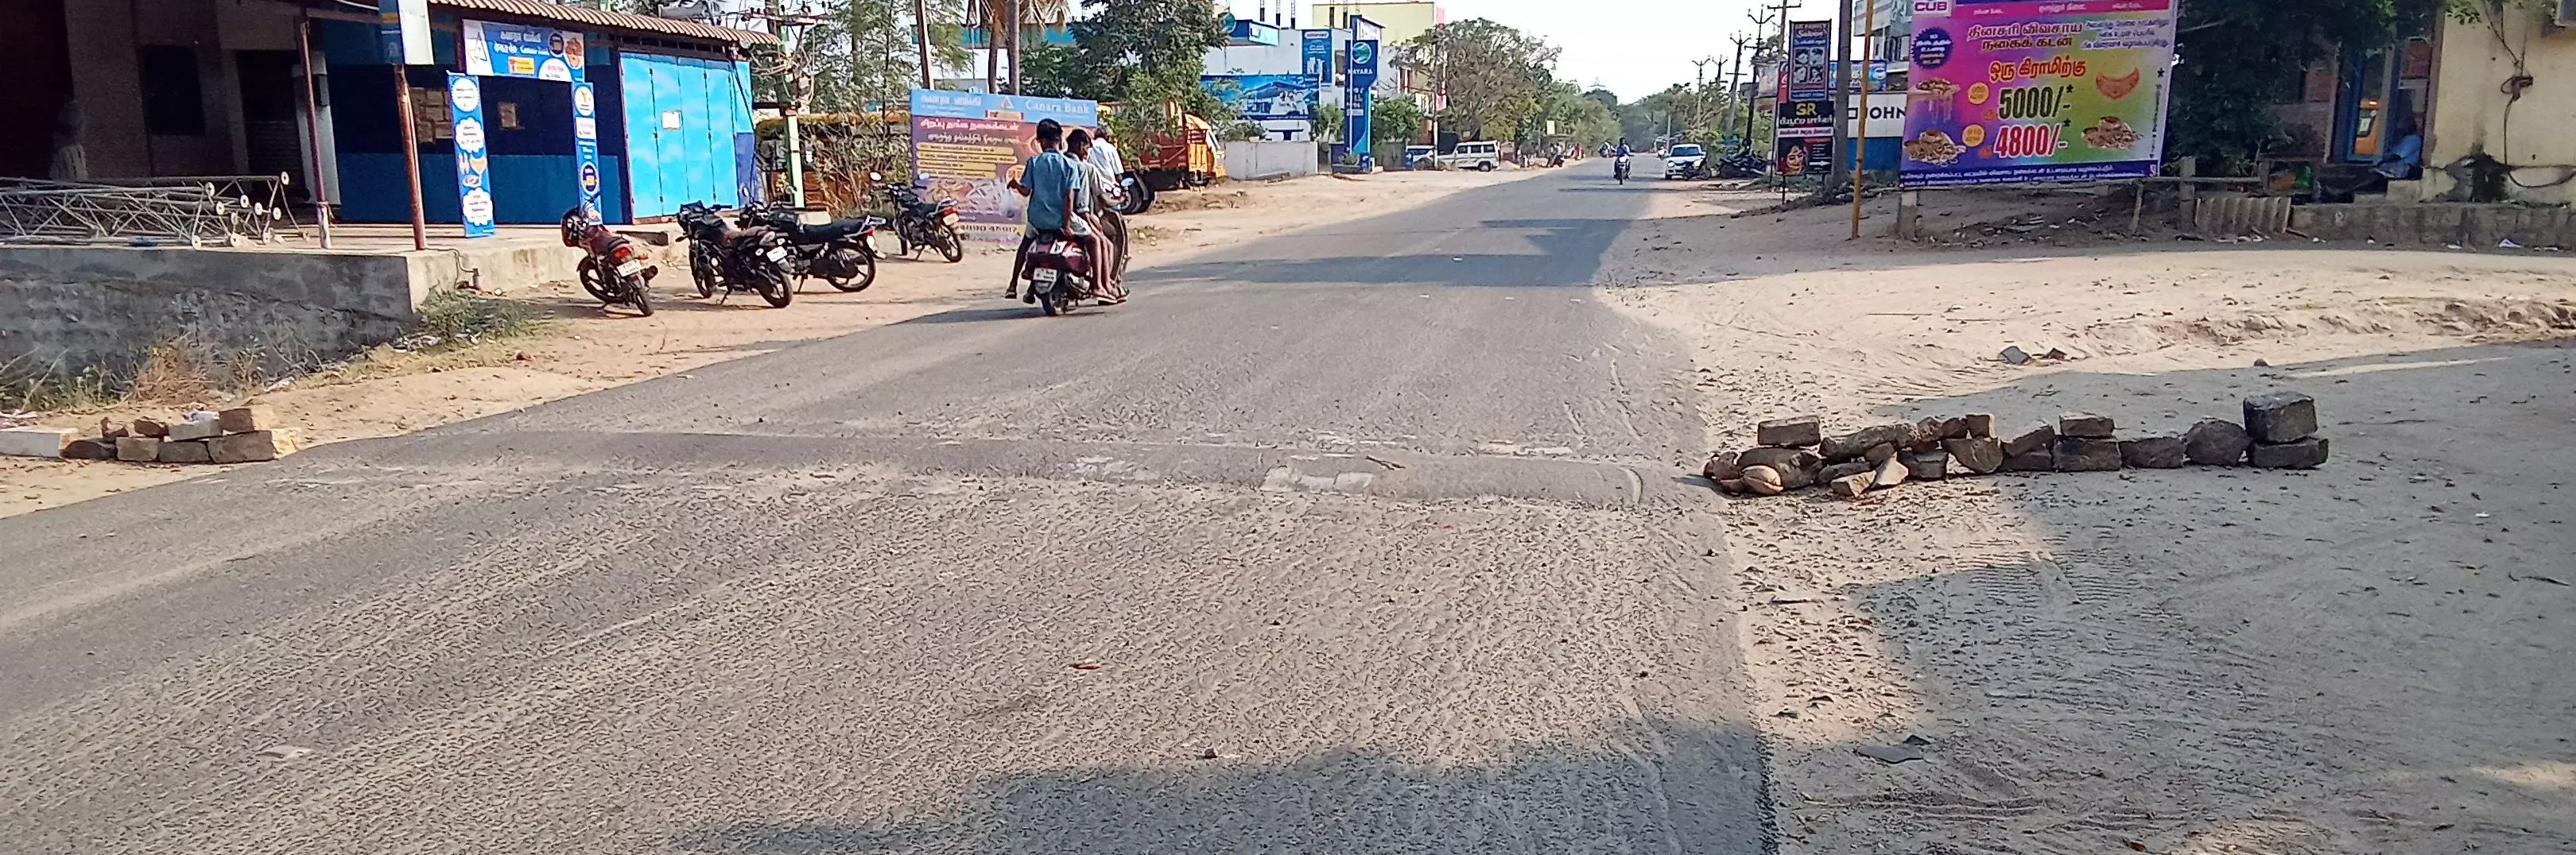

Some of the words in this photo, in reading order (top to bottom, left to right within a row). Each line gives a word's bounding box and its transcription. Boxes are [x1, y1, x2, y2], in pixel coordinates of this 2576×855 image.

[1915, 2, 1948, 12] CUB
[2022, 22, 2082, 35] விவசாய
[2036, 34, 2073, 48] கடன்
[1990, 61, 2016, 82] ஒரு
[2019, 55, 2086, 79] கிராமிற்கு
[1025, 99, 1061, 112] Canara
[1065, 103, 1090, 114] Bank
[1795, 103, 1818, 115] SR
[1866, 106, 1906, 120] OHN
